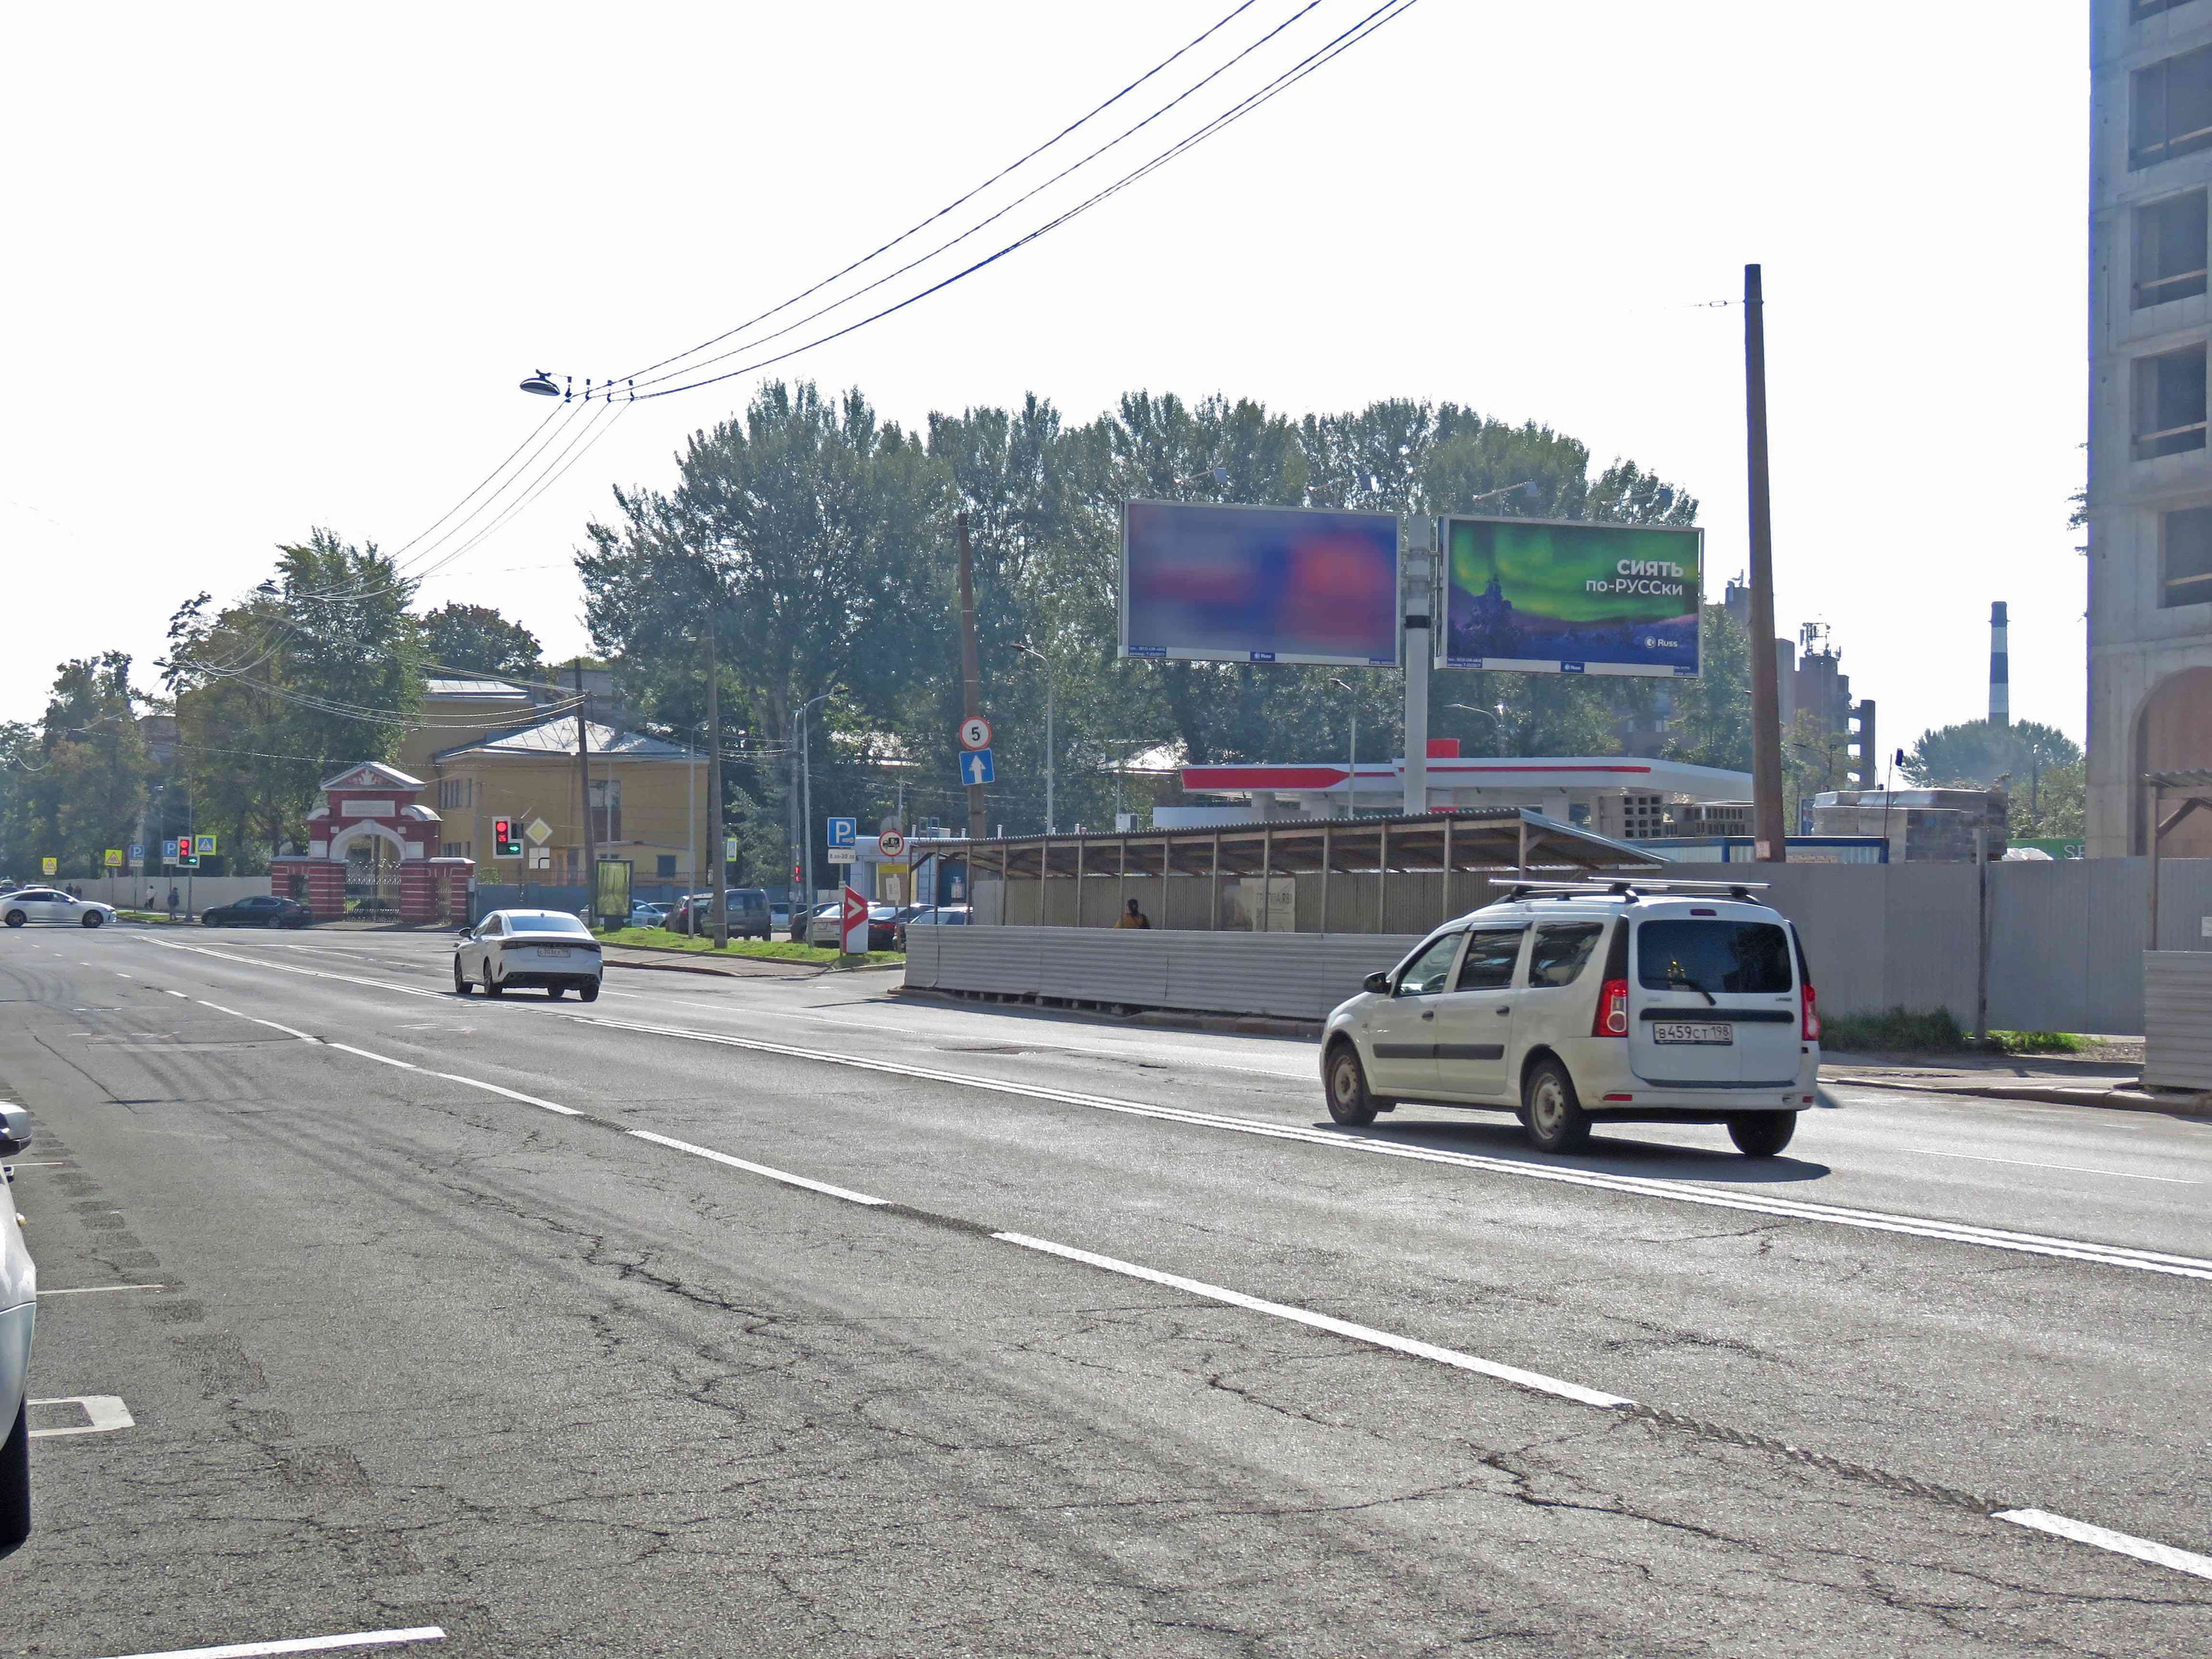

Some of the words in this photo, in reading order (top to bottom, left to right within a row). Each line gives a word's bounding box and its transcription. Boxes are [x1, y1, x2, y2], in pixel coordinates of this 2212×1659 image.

[1617, 559, 1684, 578] СИЯТЬ
[1586, 578, 1683, 596] по-РУССки
[1657, 638, 1678, 647] Russ
[971, 727, 980, 741] 5
[836, 821, 851, 844] P
[133, 847, 142, 858] P
[167, 842, 176, 854] P
[1710, 1026, 1729, 1037] 198
